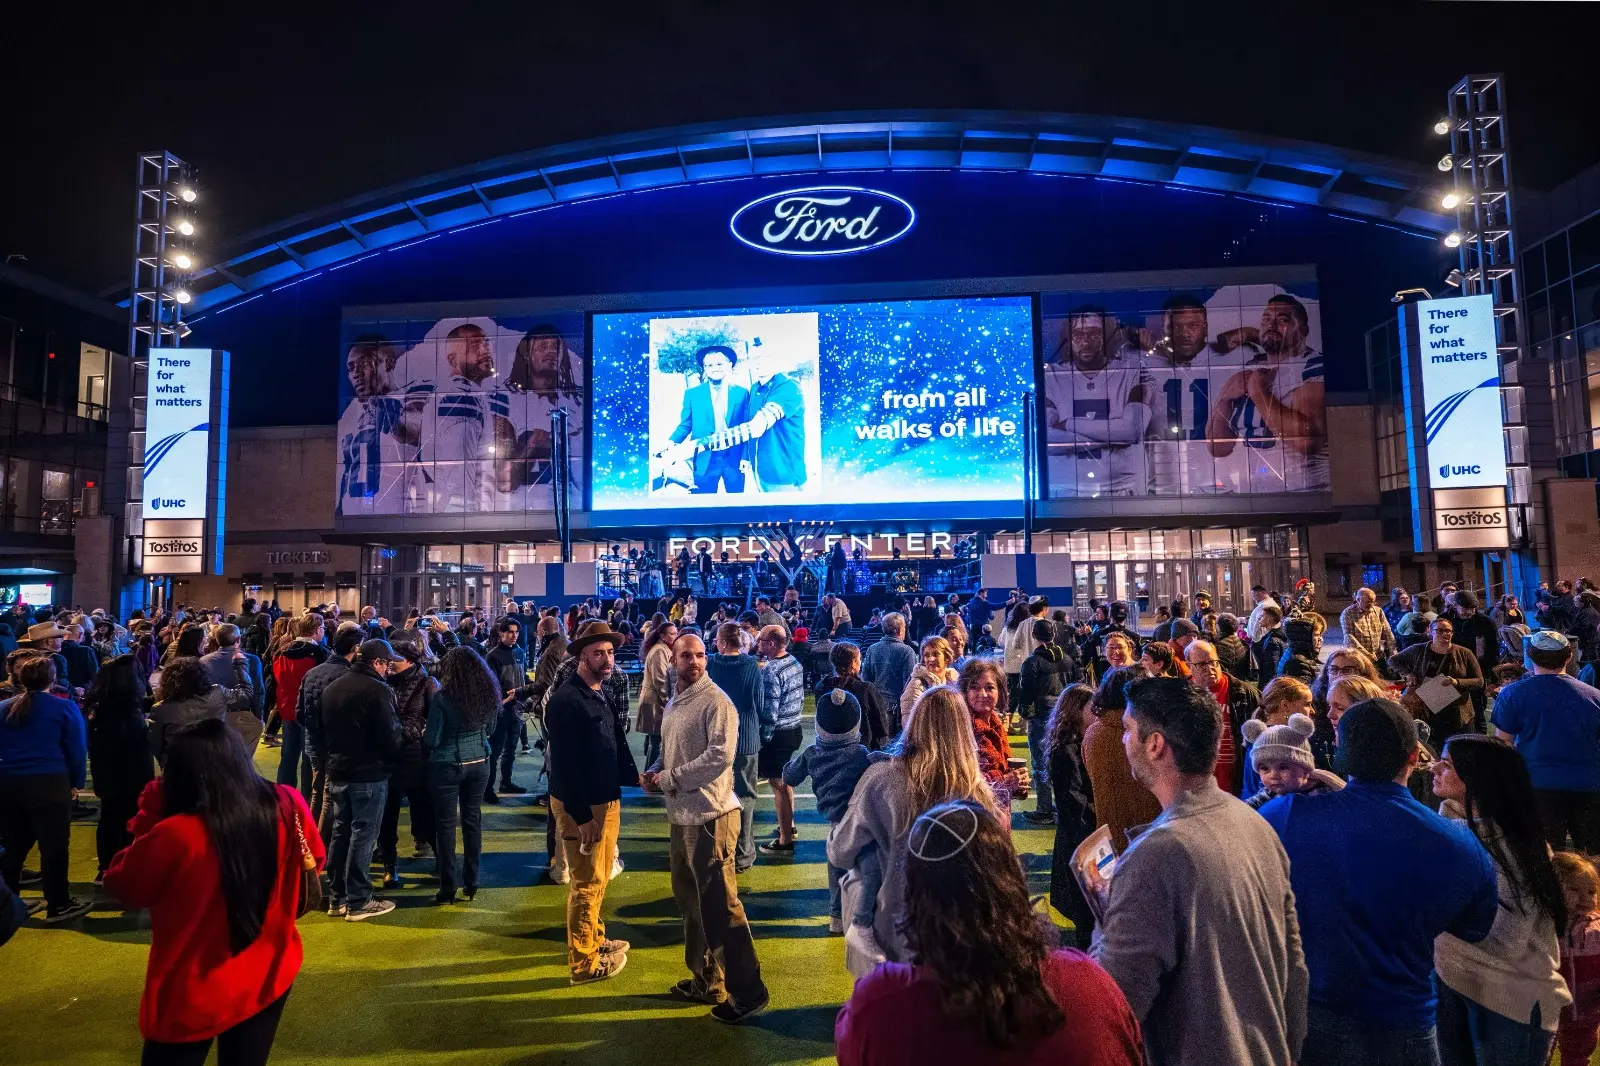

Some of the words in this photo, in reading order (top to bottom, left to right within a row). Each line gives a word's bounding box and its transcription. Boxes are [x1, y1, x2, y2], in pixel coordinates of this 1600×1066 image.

[763, 196, 882, 243] Ford
[1427, 309, 1468, 320] There
[1429, 323, 1449, 334] for
[1430, 337, 1465, 349] what
[157, 357, 191, 367] There
[1431, 351, 1488, 364] matters
[156, 370, 175, 380] for
[156, 384, 186, 393] what
[155, 397, 202, 407] matters
[882, 389, 945, 409] from
[954, 387, 986, 407] all
[855, 420, 932, 440] walks
[939, 417, 967, 438] of
[1452, 465, 1481, 475] UHC
[162, 499, 186, 508] UHC
[669, 536, 771, 556] FORD
[266, 551, 331, 564] TICKETS
